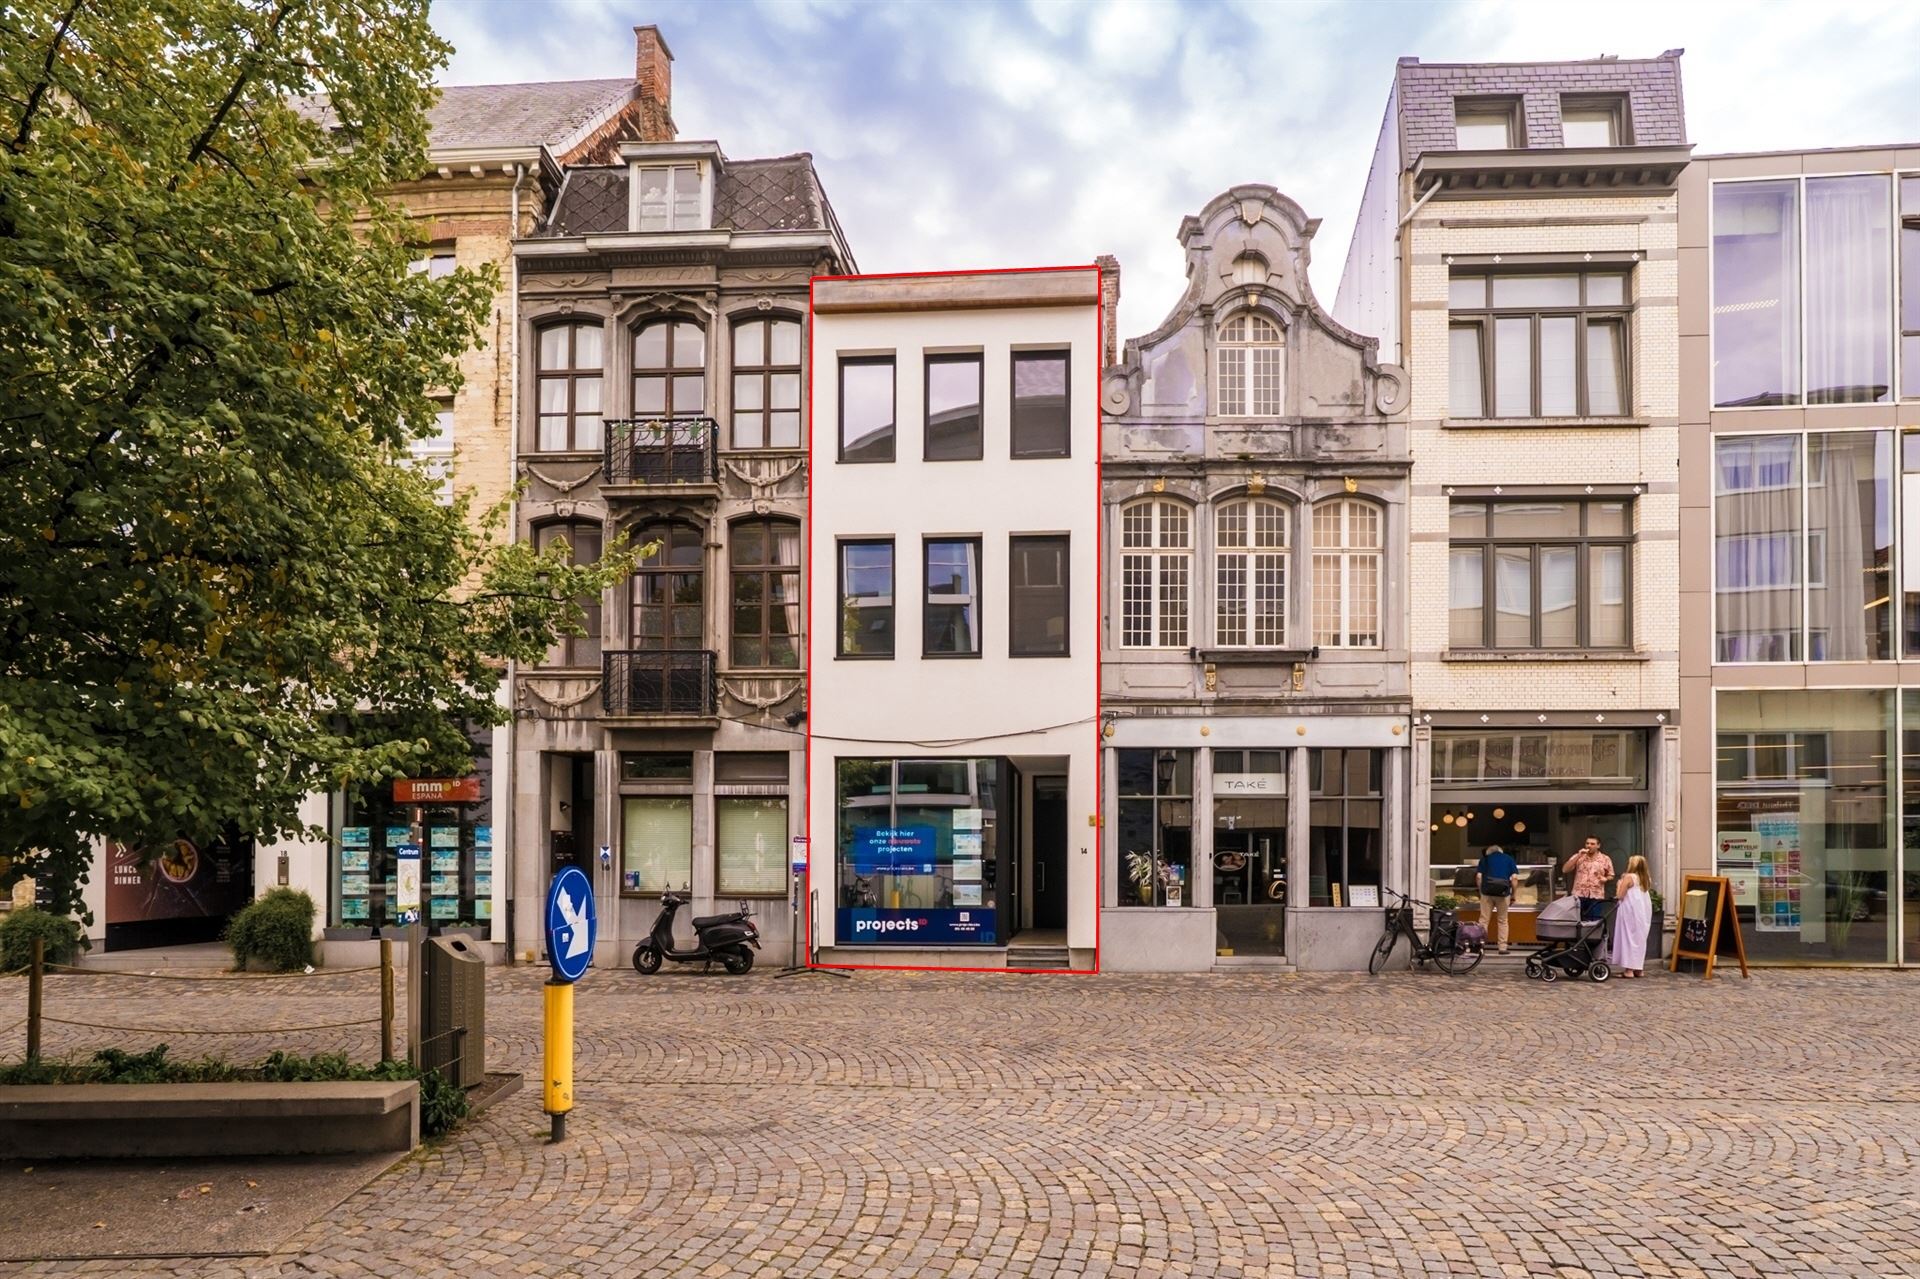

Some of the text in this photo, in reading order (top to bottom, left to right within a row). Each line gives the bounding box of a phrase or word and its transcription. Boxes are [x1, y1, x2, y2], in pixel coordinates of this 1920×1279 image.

[1225, 778, 1267, 789] TAKÉ
[877, 846, 913, 854] projecten
[114, 876, 142, 885] DINNER
[856, 918, 919, 933] projects
